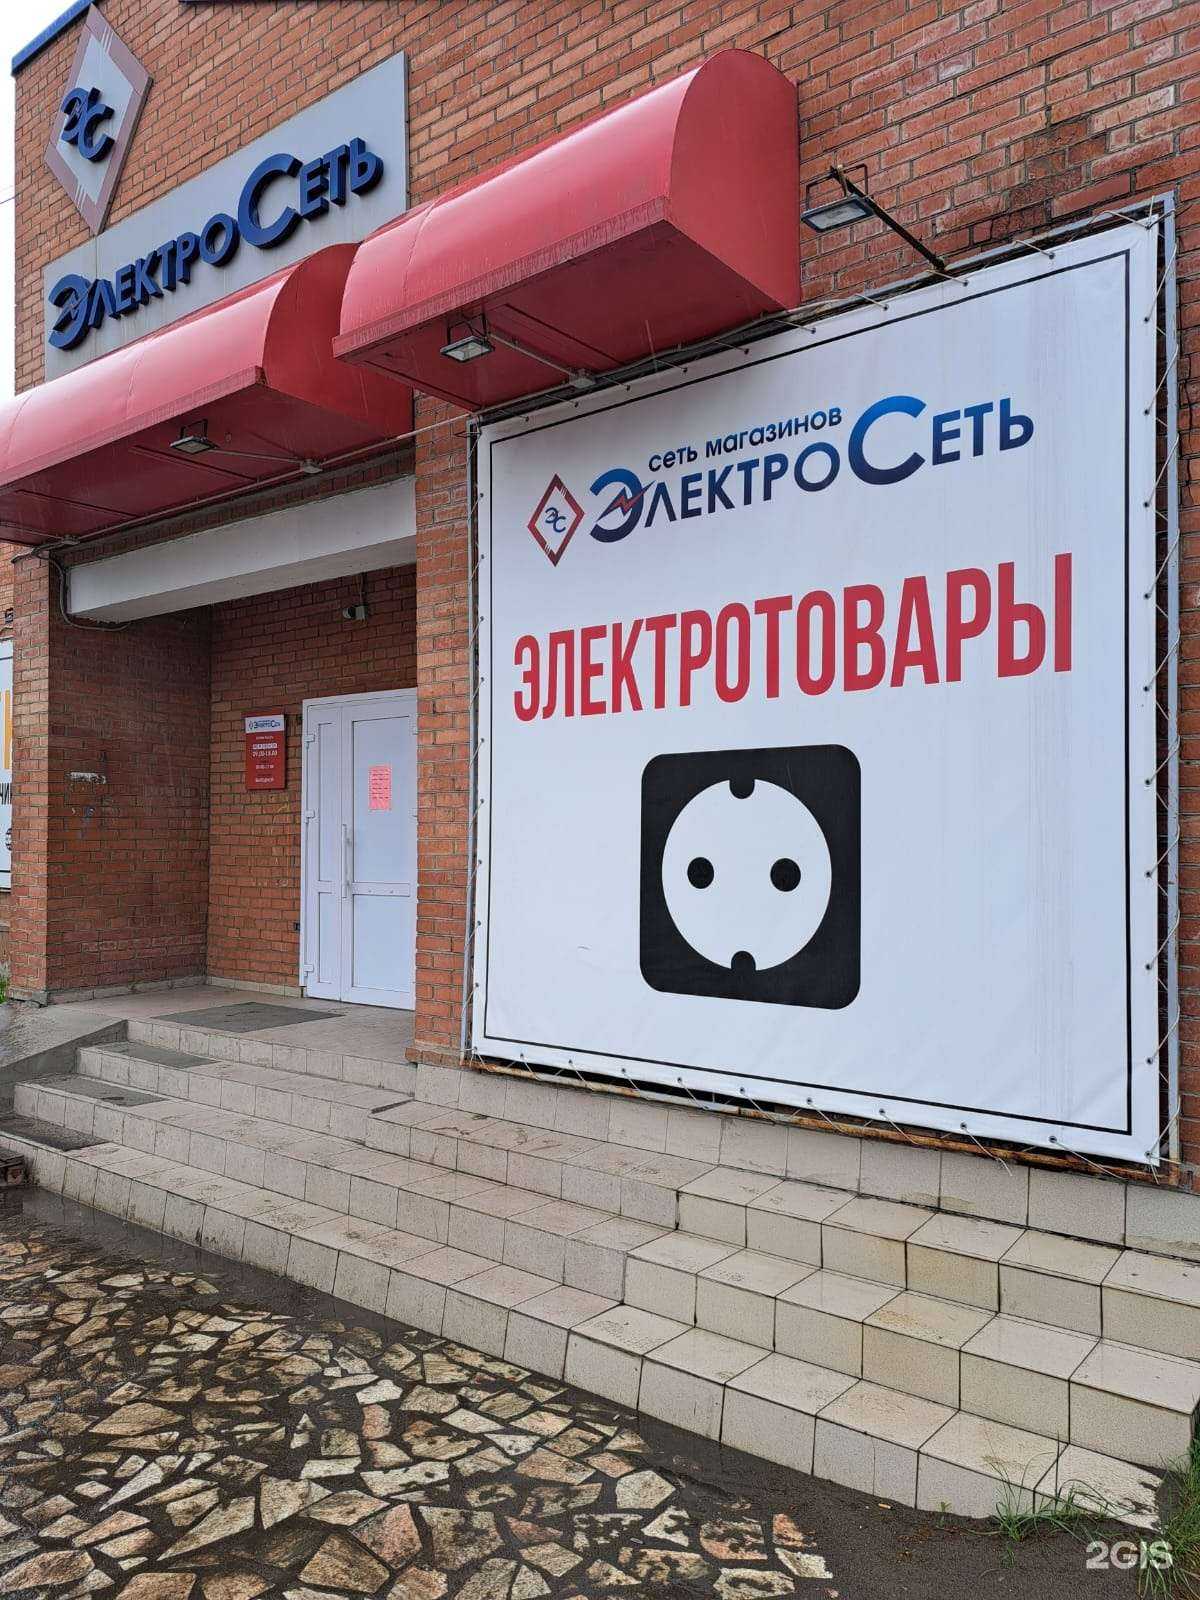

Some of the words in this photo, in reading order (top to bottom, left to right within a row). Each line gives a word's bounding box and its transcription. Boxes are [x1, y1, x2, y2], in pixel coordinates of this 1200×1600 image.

[648, 445, 698, 472] сеть
[705, 407, 842, 458] магазинов
[513, 552, 1073, 722] ЭЛЕКТРОТОВАРЫ
